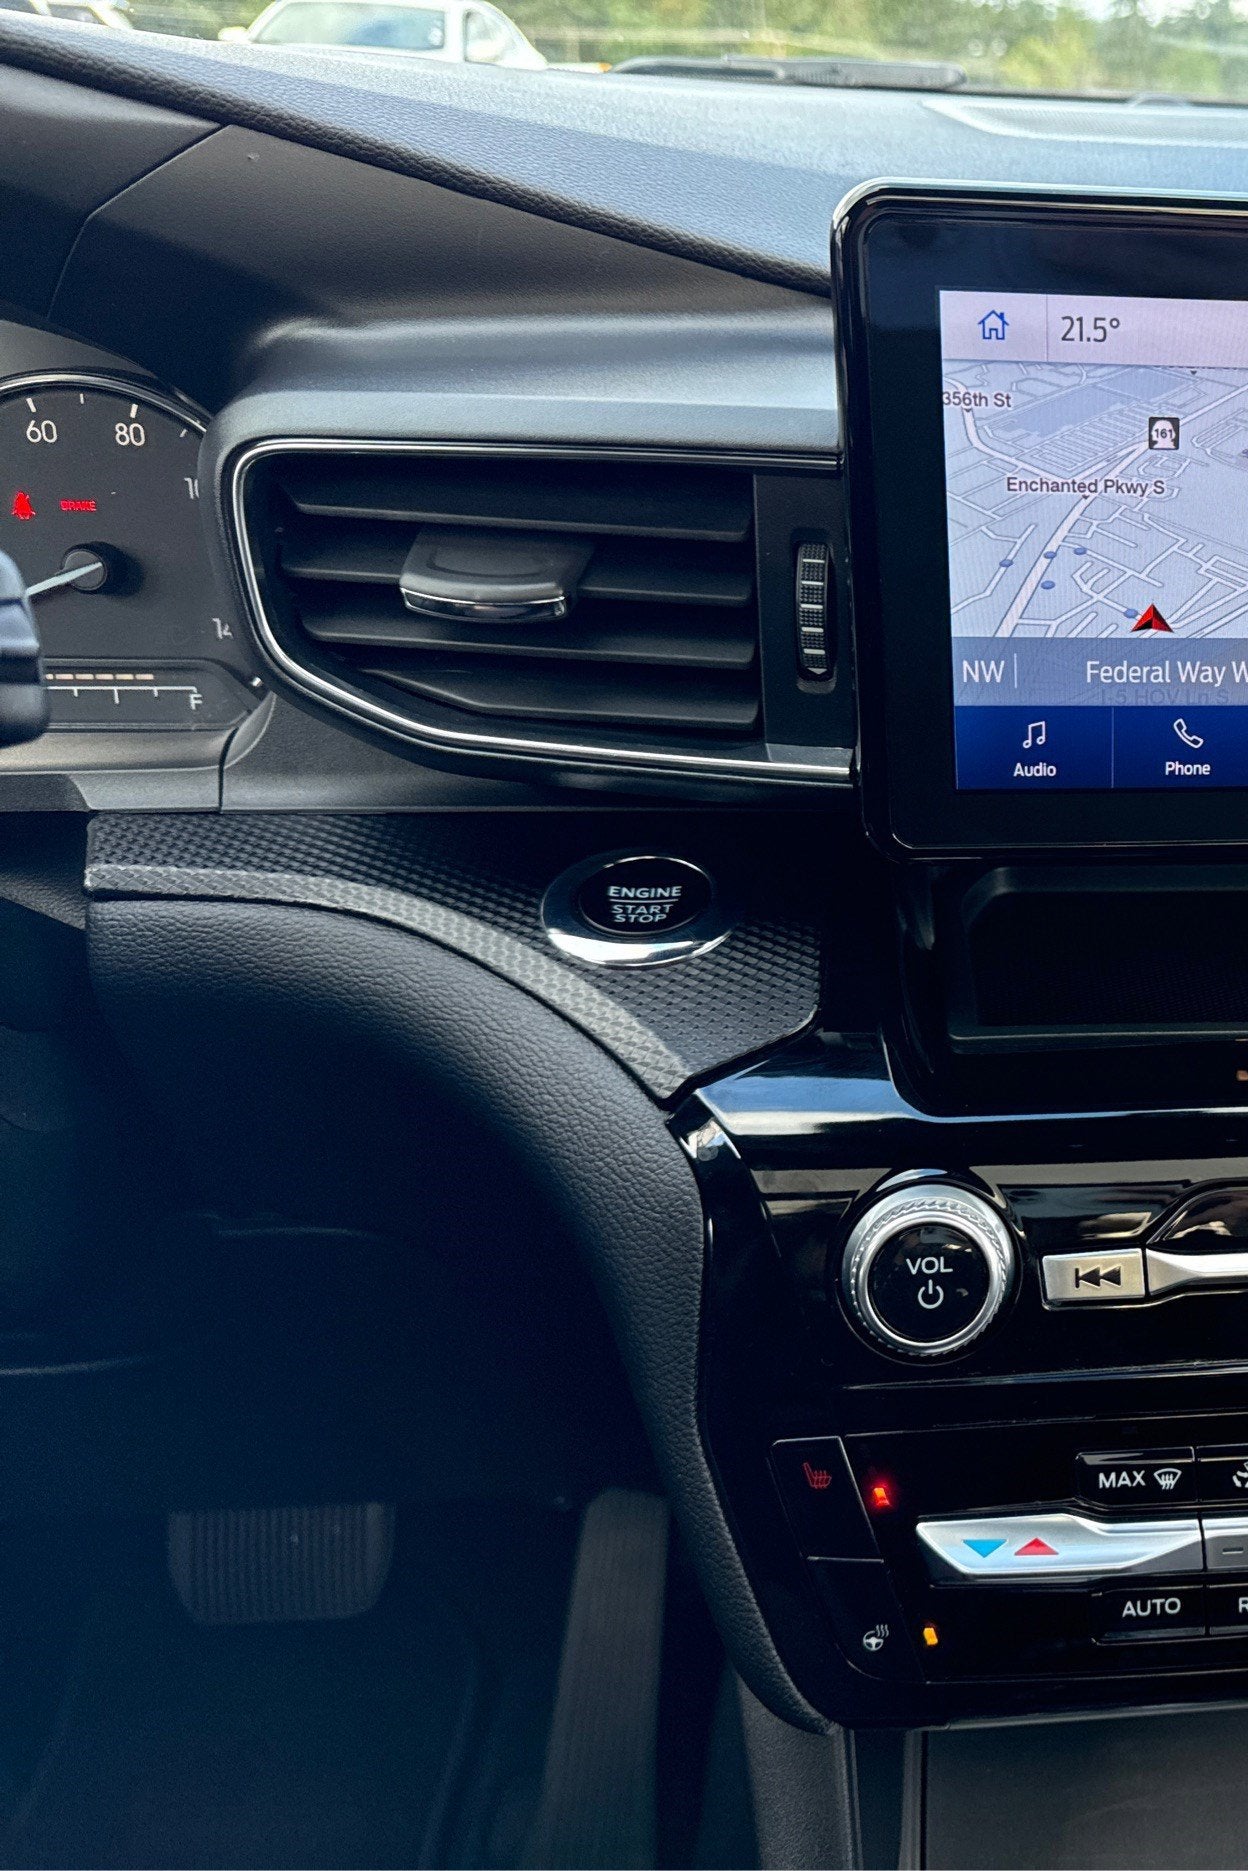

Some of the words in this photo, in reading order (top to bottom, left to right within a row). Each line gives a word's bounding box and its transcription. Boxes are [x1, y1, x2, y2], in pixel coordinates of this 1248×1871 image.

[1061, 316, 1121, 344] 21.5°
[942, 391, 989, 408] 356th
[994, 393, 1012, 408] St
[26, 420, 58, 443] 60
[115, 422, 145, 446] 80
[1154, 428, 1174, 440] 161
[1006, 477, 1098, 496] Enchanted
[1103, 478, 1149, 498] Pkwy
[1153, 481, 1165, 495] S
[60, 499, 97, 512] BRAKE
[962, 660, 1005, 683] NW
[1086, 661, 1170, 683] Federal
[1177, 661, 1224, 687] Way
[189, 693, 203, 710] F
[1013, 763, 1057, 778] Audio
[1165, 761, 1211, 776] Phone
[607, 885, 682, 898] ENGINE
[611, 904, 674, 914] START
[613, 914, 667, 923] STOP
[906, 1256, 954, 1275] VOL
[1098, 1470, 1146, 1489] MAX
[1122, 1597, 1181, 1617] AUTO
